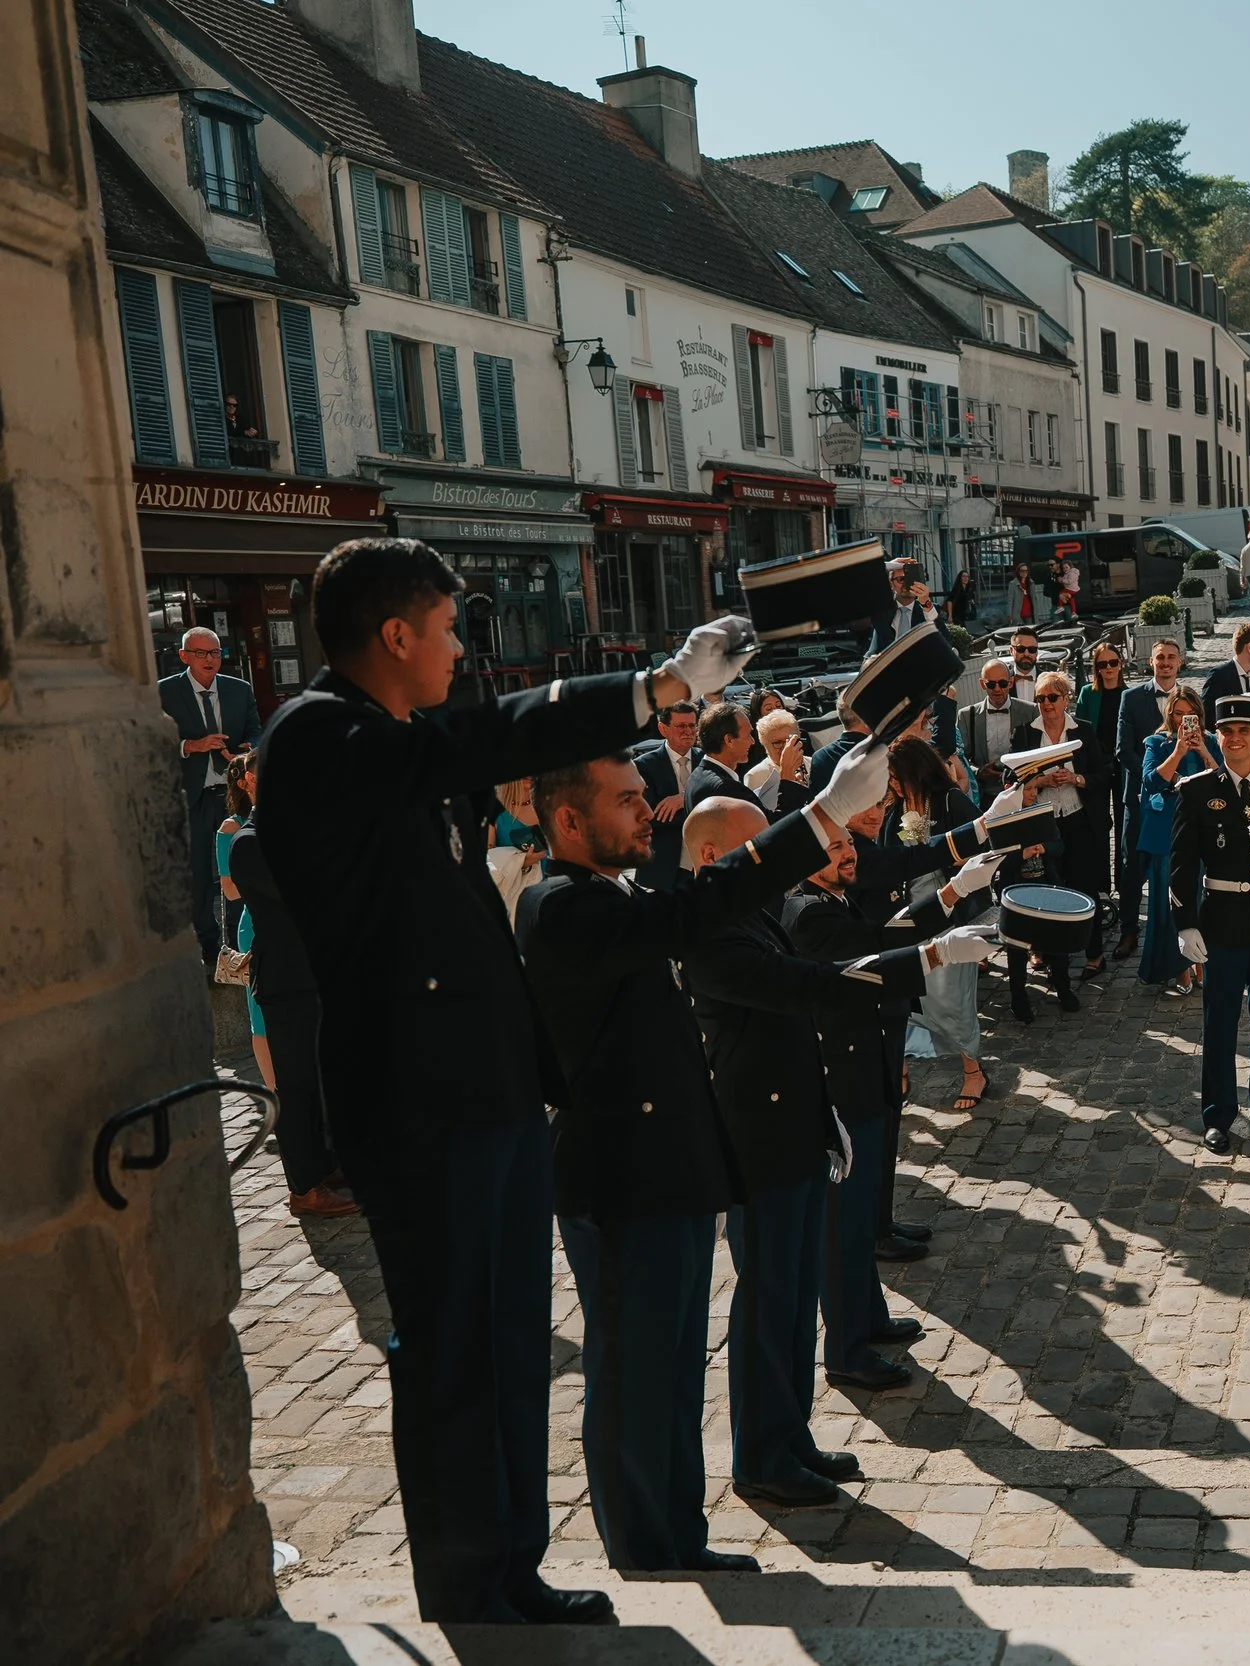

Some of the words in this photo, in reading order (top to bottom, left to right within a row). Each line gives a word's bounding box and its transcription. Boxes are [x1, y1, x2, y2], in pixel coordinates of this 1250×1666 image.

[677, 339, 728, 368] RESTAURANT
[875, 355, 927, 373] IMMOBILIER
[680, 360, 727, 388] BRASSERIE
[834, 464, 871, 480] AGENE
[742, 487, 775, 499] BRASSERIE
[211, 489, 242, 511] DU
[246, 490, 332, 517] KASHMIR
[647, 514, 692, 527] RESTAURANT
[459, 525, 470, 536] Le
[473, 525, 505, 538] Bistrot
[508, 527, 522, 538] des
[525, 528, 547, 540] Tours
